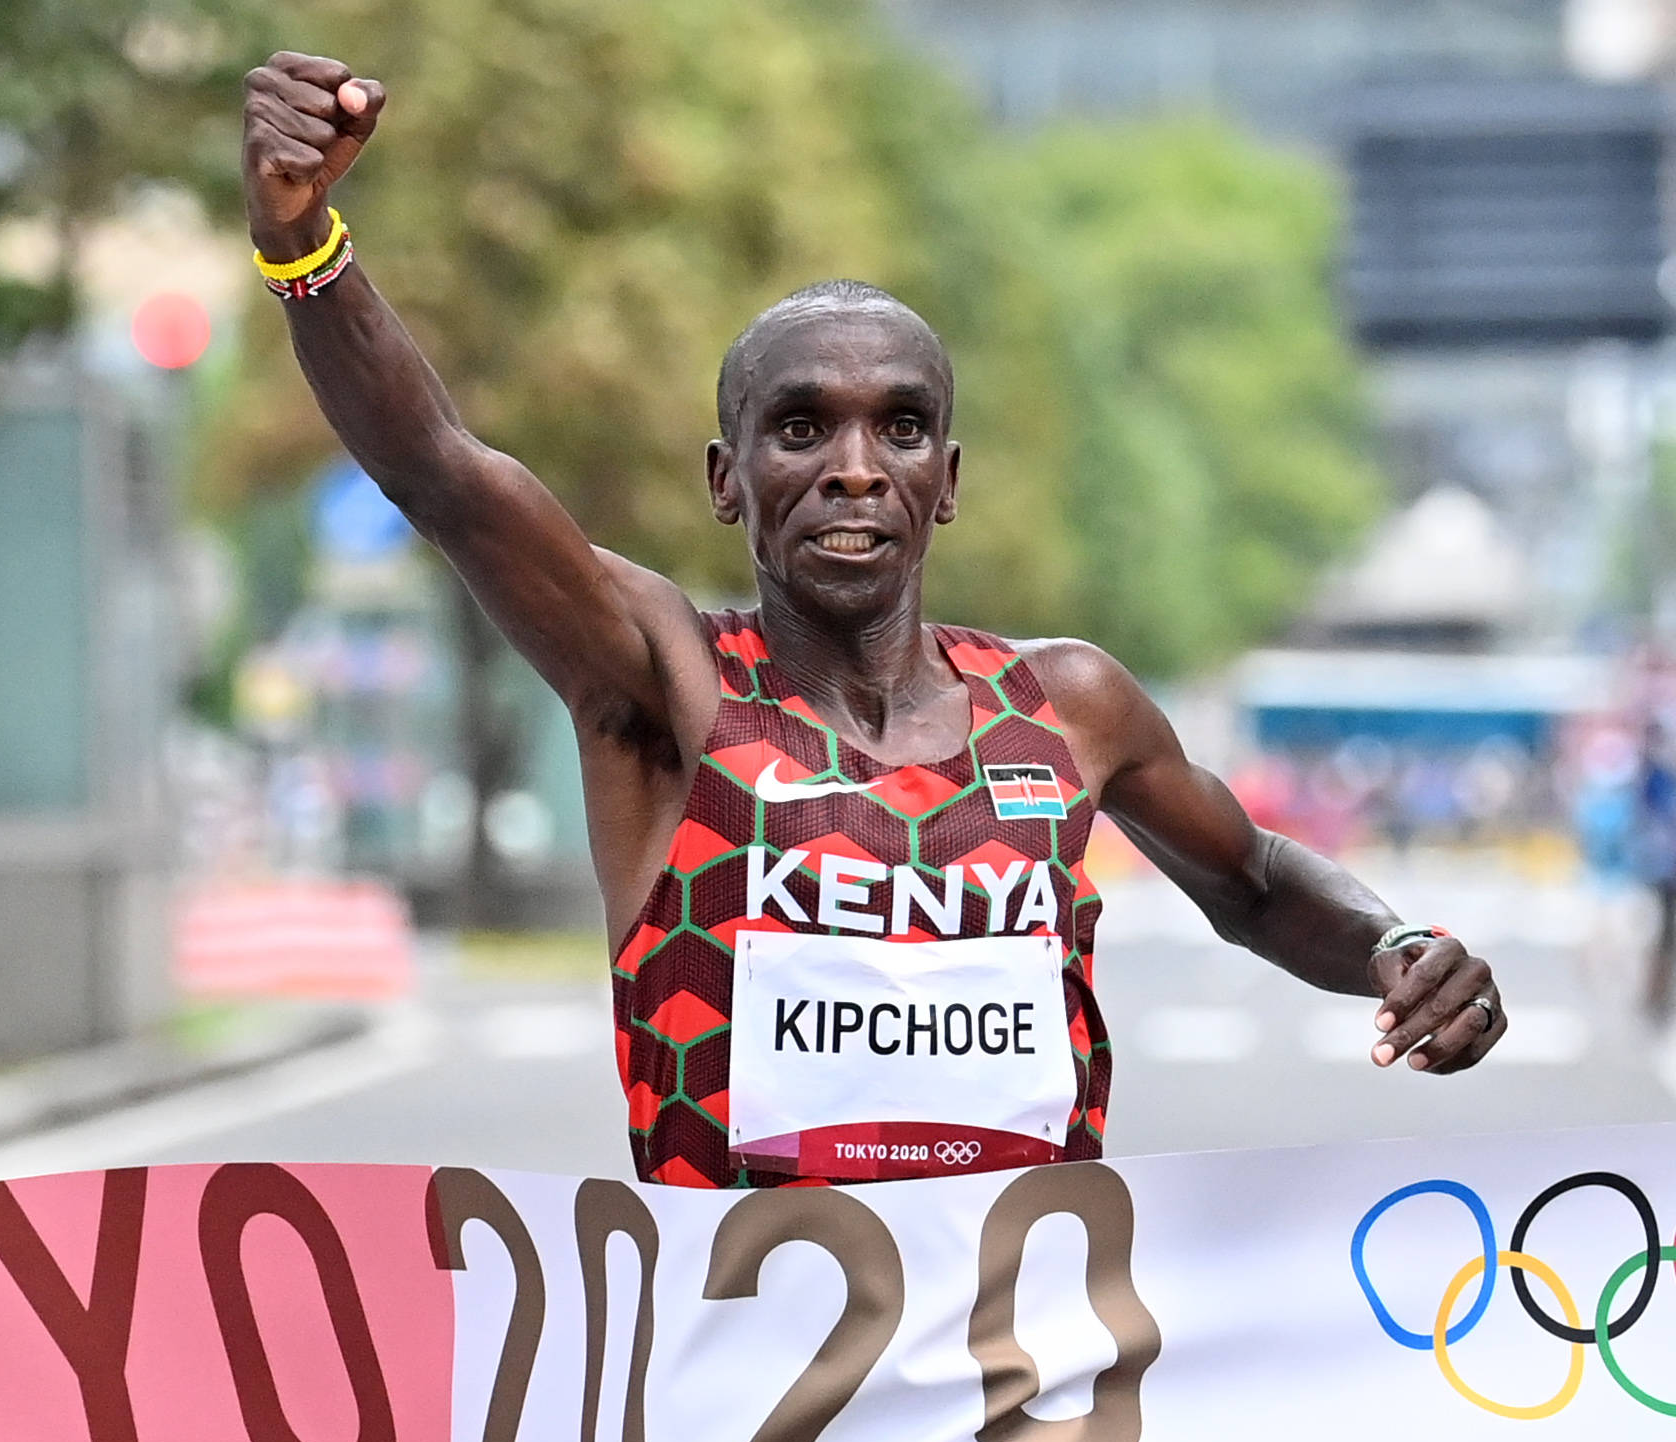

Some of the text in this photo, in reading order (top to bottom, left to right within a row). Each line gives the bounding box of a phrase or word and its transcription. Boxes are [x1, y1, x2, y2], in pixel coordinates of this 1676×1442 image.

[746, 846, 1058, 935] KENYA
[774, 998, 1036, 1056] KIPCHOGE
[834, 1143, 929, 1161] TOKYO 2020
